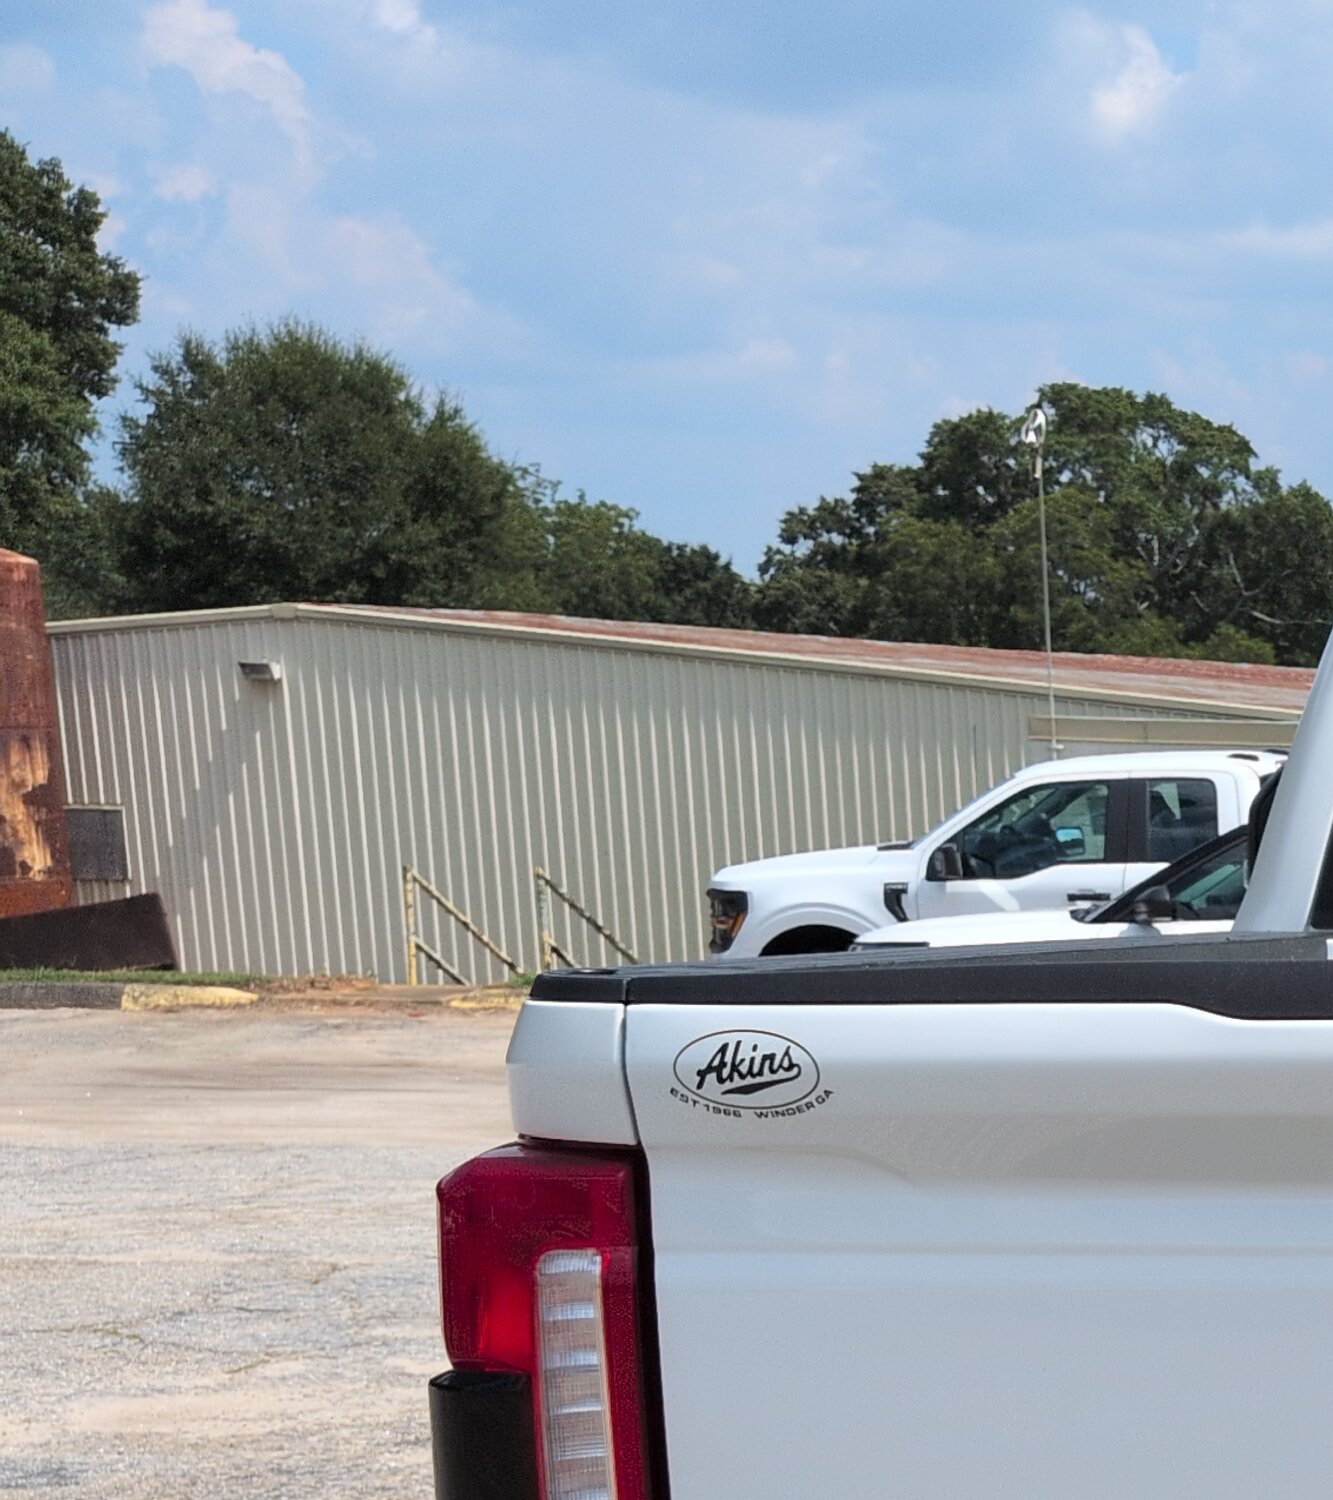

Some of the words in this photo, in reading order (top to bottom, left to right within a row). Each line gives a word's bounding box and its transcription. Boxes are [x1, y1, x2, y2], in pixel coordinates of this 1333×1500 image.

[696, 1039, 801, 1095] Akins
[670, 1088, 700, 1107] EST
[754, 1106, 815, 1119] WINDER
[815, 1089, 834, 1105] GA
